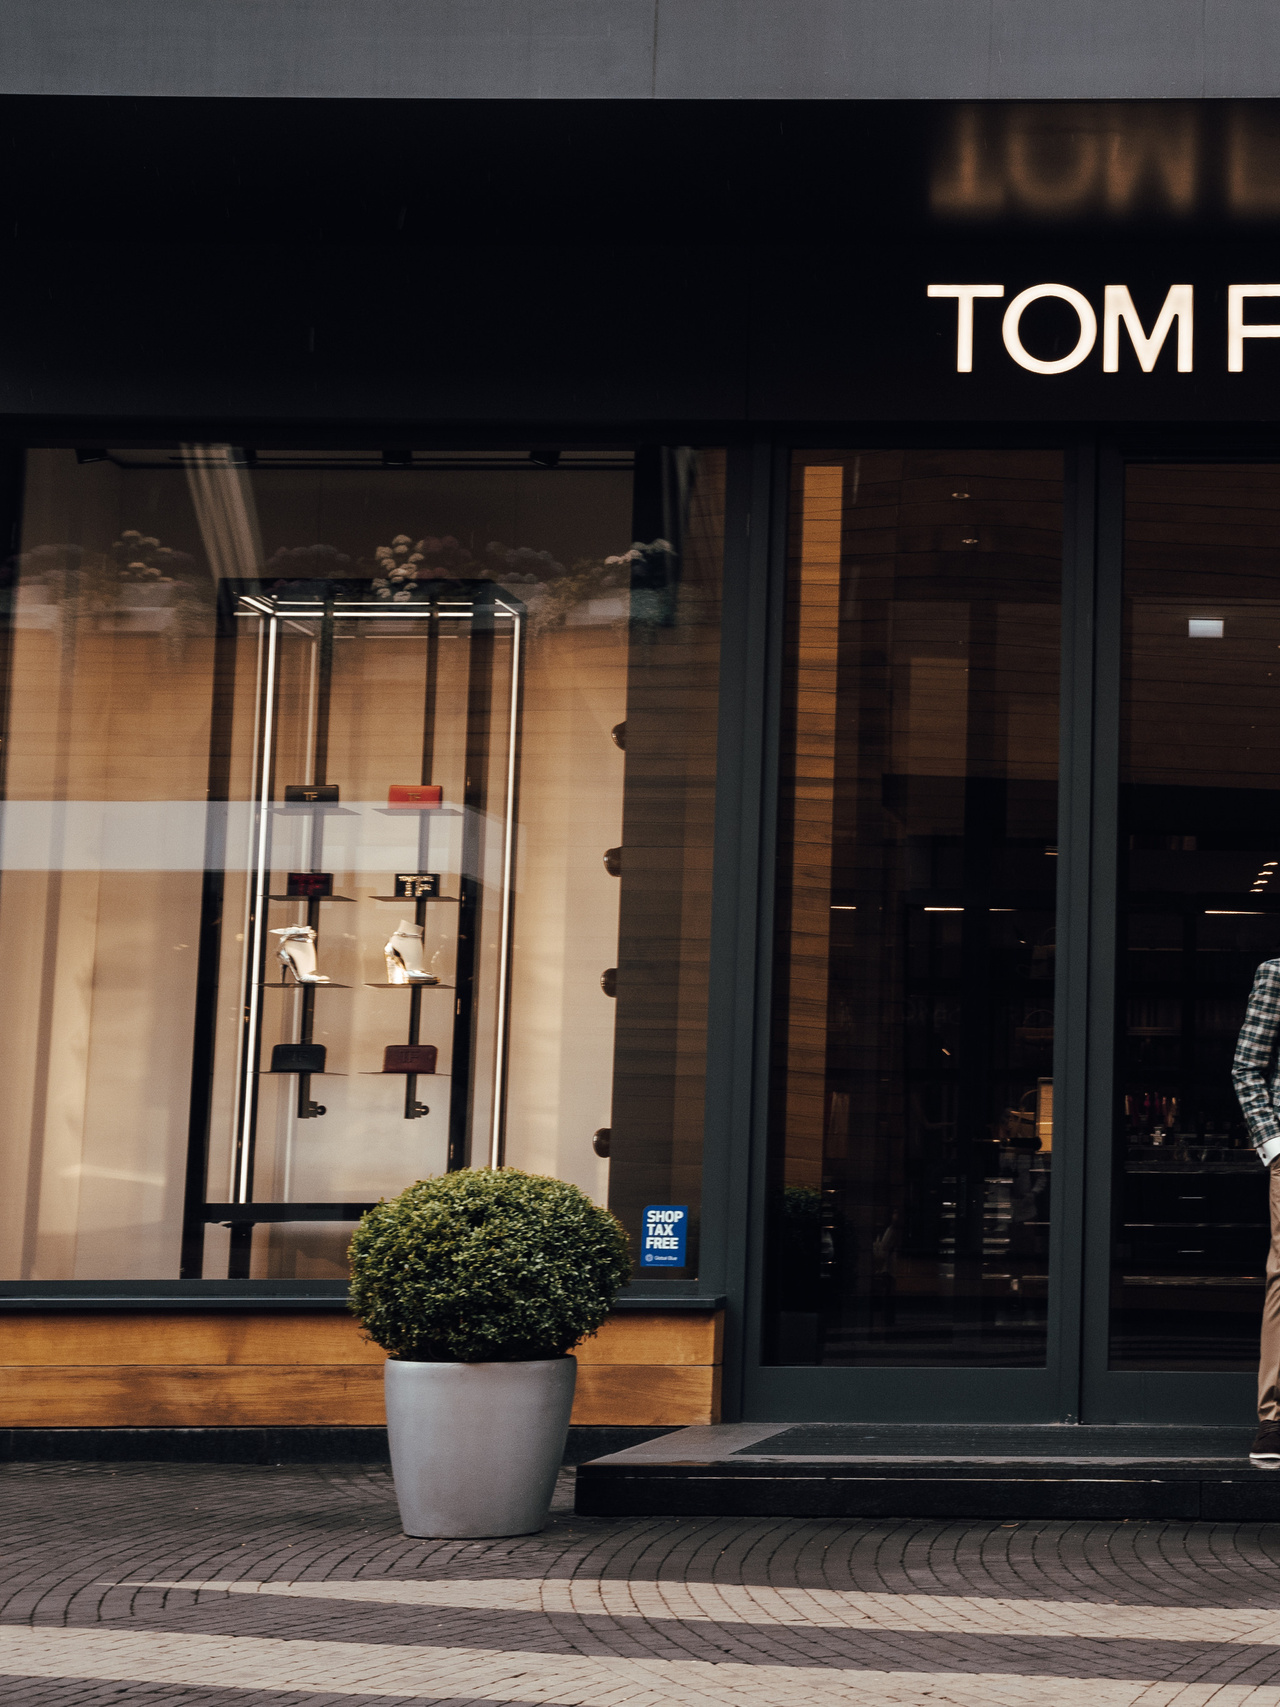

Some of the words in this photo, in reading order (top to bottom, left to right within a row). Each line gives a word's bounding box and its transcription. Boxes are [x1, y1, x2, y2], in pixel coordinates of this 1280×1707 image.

[927, 283, 1194, 374] TOM
[646, 1210, 684, 1223] SHOP
[646, 1223, 674, 1236] TAX
[645, 1237, 679, 1249] FREE
